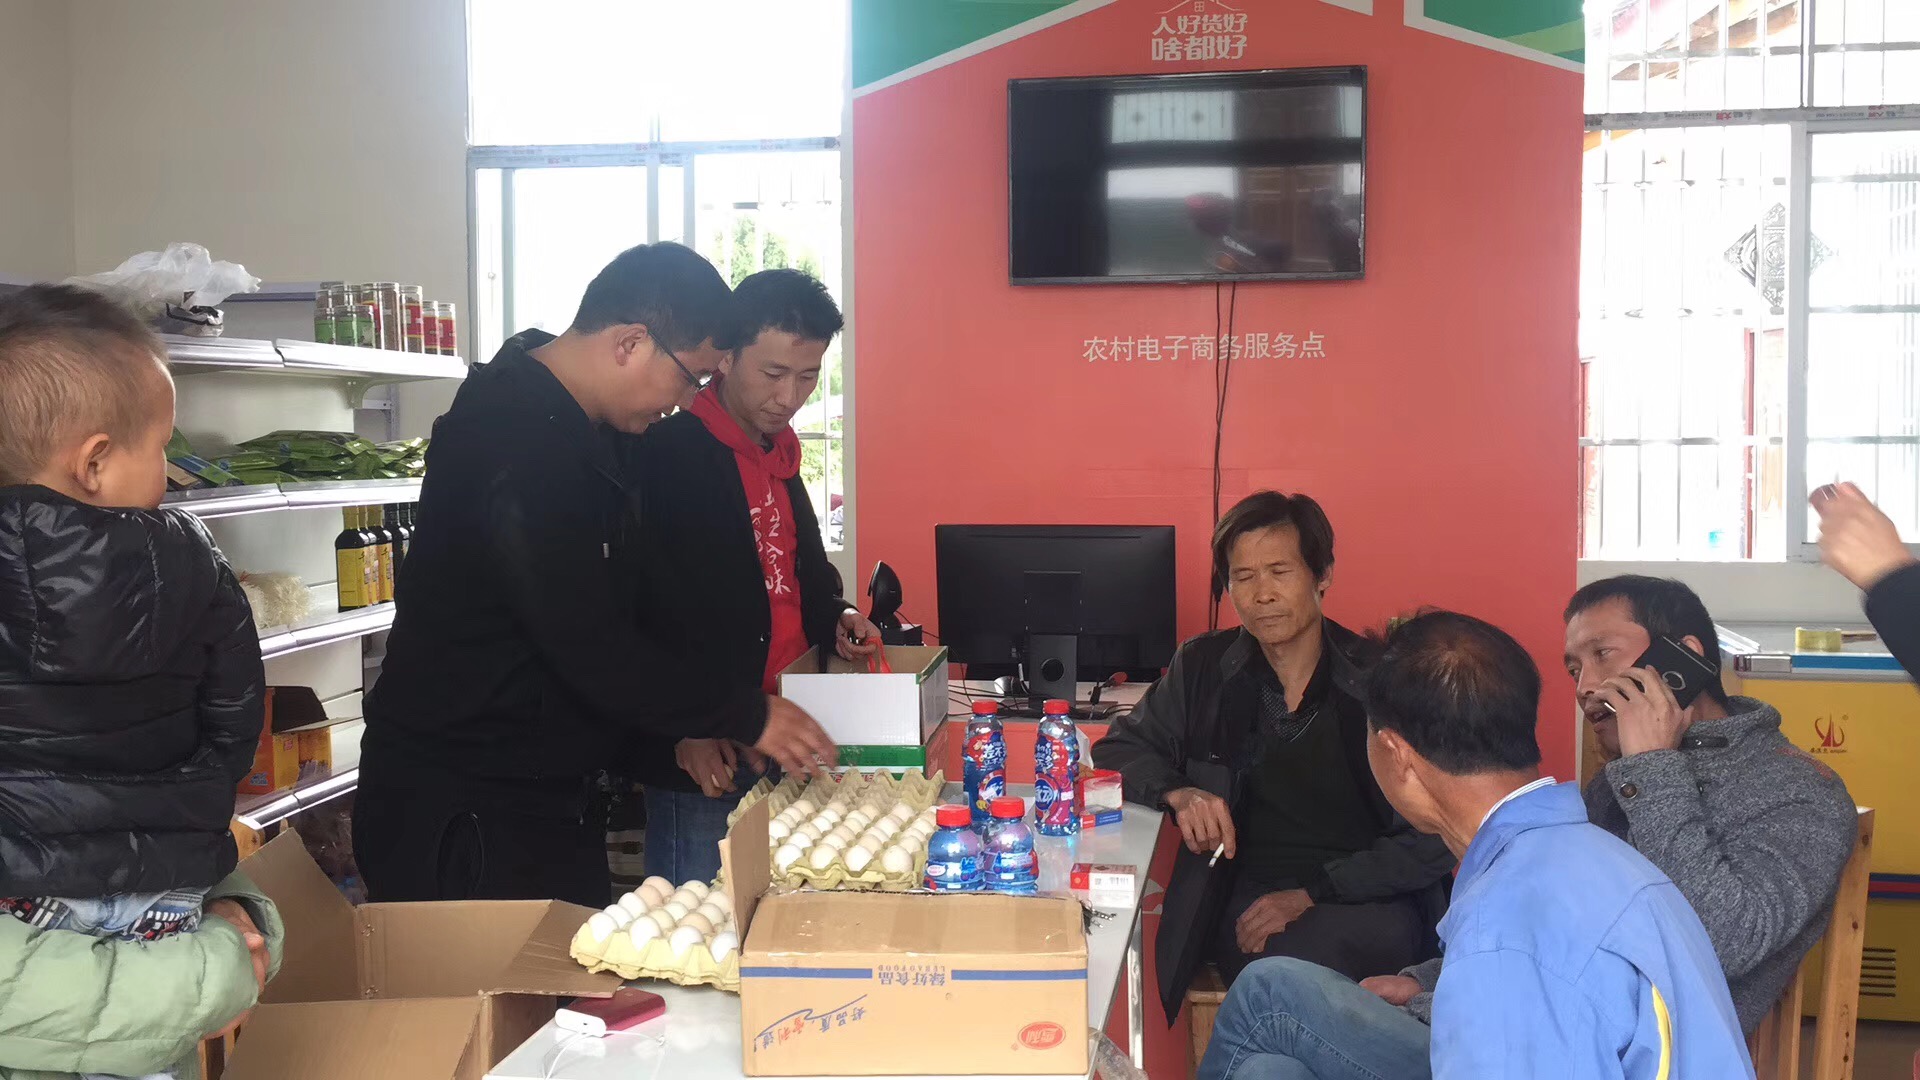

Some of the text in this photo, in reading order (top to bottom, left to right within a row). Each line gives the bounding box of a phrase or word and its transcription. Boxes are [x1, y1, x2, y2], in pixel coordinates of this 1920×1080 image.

[1152, 13, 1248, 36] 人好货好
[1151, 35, 1247, 61] 啥都好
[1082, 331, 1326, 363] 农村电子商务服务点
